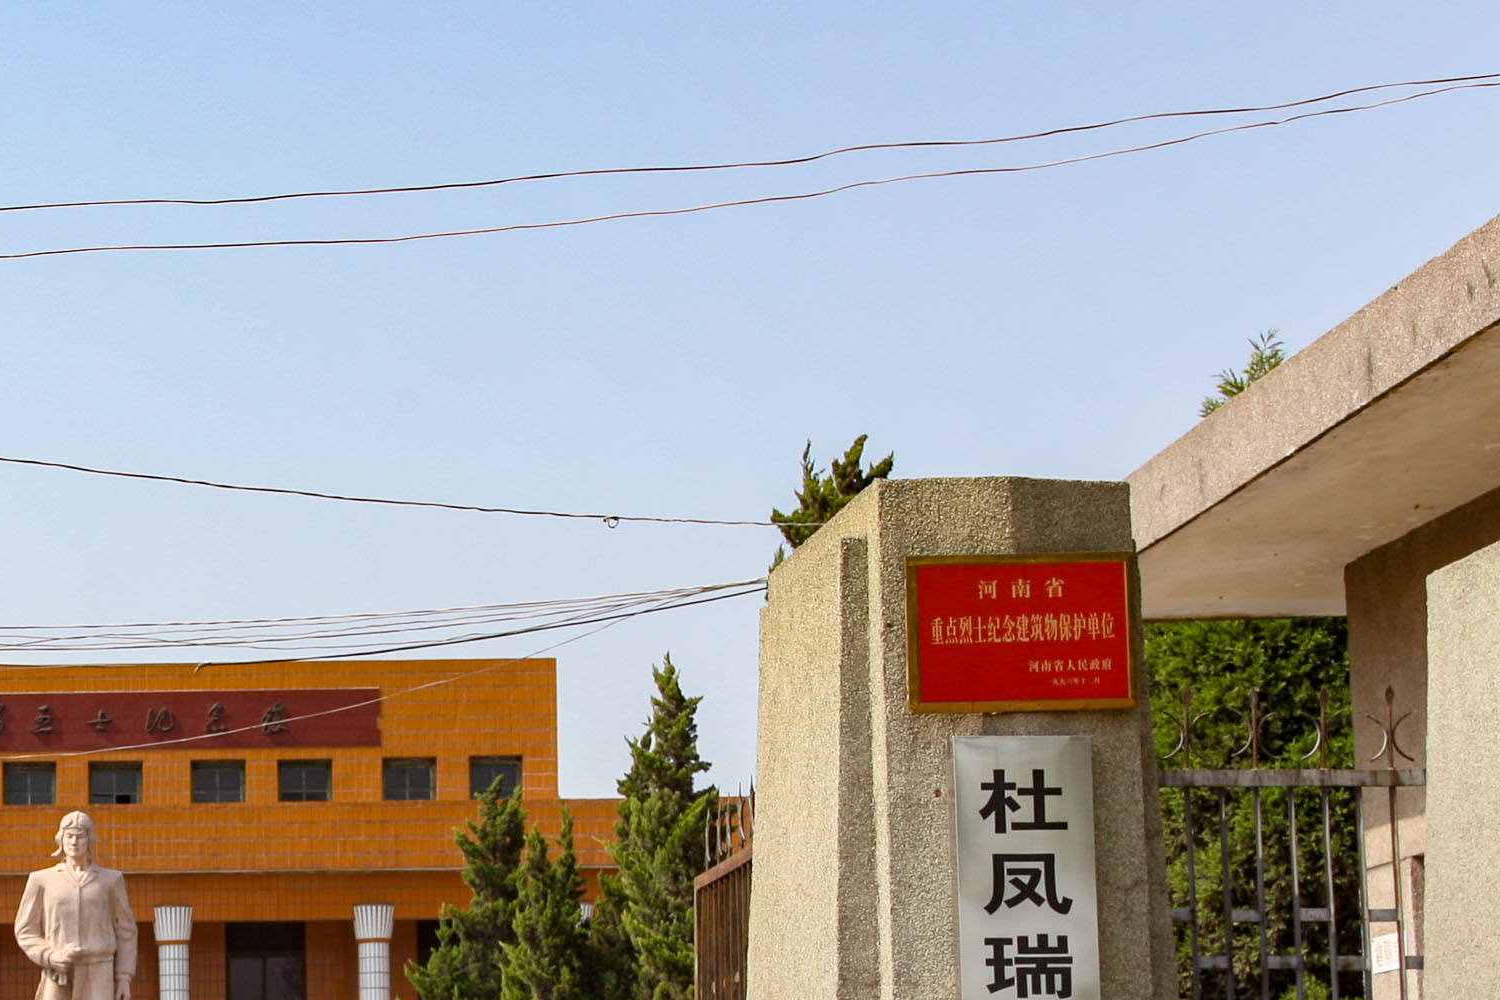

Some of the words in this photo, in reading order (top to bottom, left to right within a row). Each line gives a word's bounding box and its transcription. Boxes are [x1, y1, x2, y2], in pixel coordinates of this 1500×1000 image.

[978, 577, 1065, 599] 河南省
[931, 611, 1115, 645] 重点烈士纪念建筑物保护单位
[1028, 658, 1113, 673] 河南省人民政府
